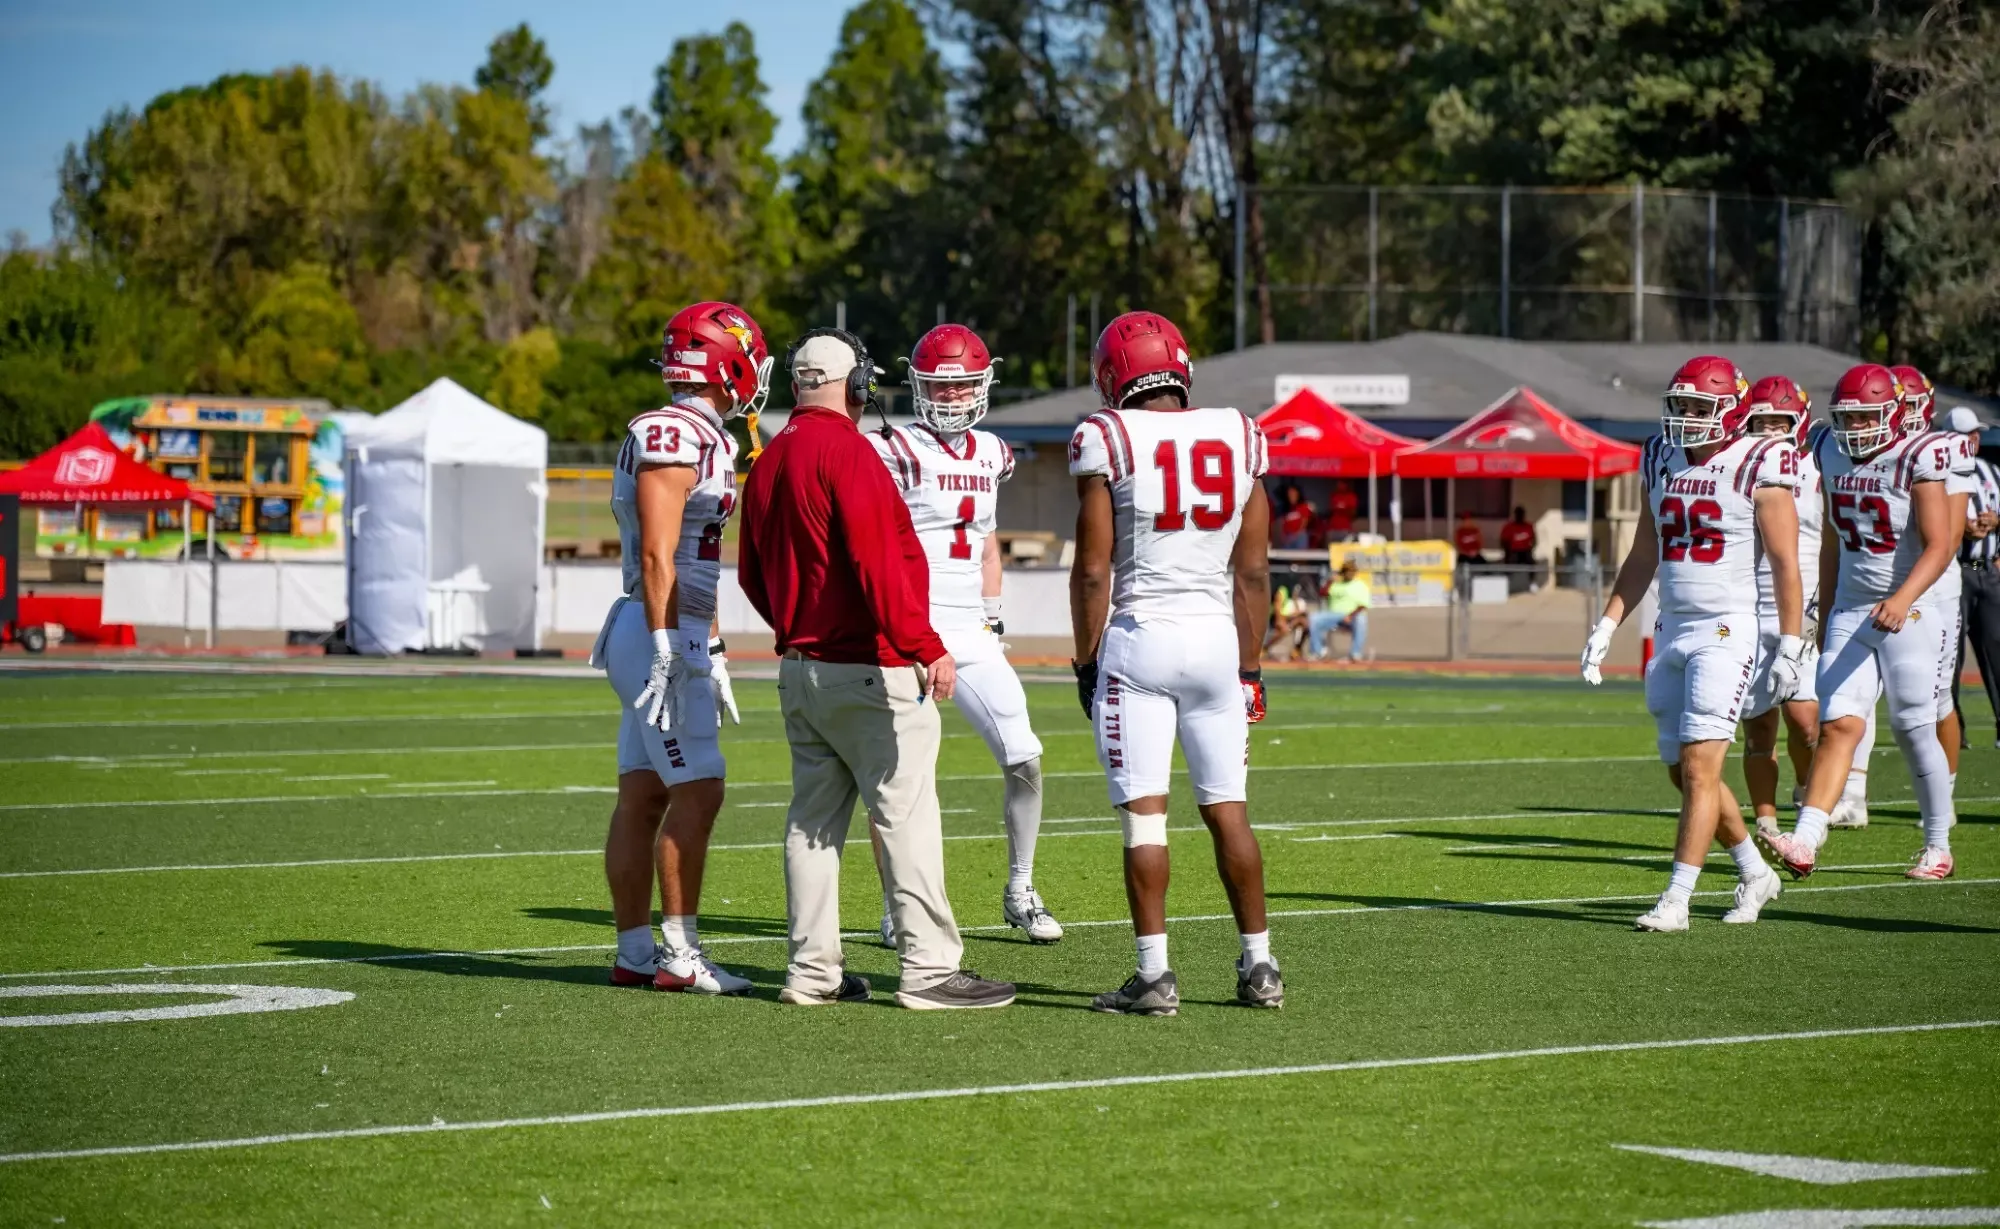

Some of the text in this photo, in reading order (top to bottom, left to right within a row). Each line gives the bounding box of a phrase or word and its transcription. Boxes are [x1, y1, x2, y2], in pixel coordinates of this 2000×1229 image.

[1137, 371, 1170, 386] schutt
[646, 424, 681, 454] 23
[1068, 431, 1084, 464] 9
[1780, 450, 1799, 476] 26
[937, 474, 991, 493] VIKINGS
[1153, 439, 1235, 531] 19
[1833, 475, 1881, 493] VIKINGS
[948, 495, 976, 561] 1
[1659, 496, 1725, 563] 26
[1831, 492, 1897, 554] 53
[1105, 675, 1123, 768] WE ALL ROW
[664, 738, 686, 768] ROW
